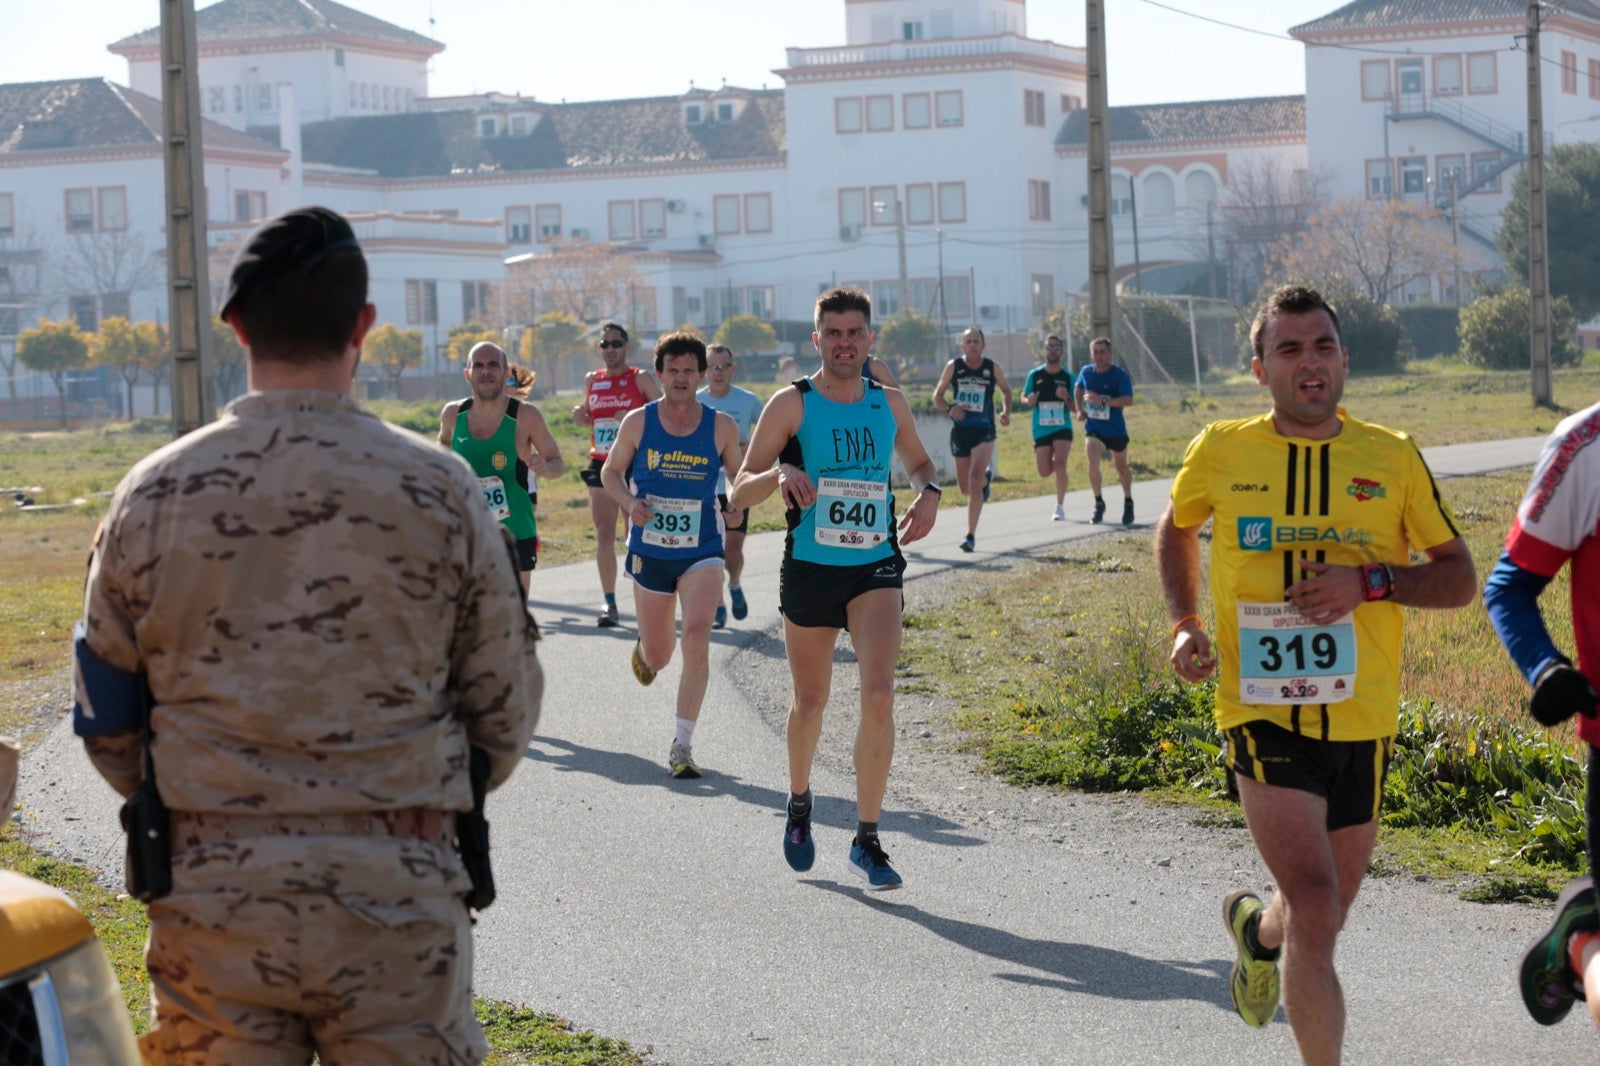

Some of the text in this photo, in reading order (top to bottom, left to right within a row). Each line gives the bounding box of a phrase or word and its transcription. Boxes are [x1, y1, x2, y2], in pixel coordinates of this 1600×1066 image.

[959, 391, 980, 404] 810
[832, 426, 876, 463] ENA
[663, 451, 708, 466] olimpo
[654, 512, 691, 533] 393
[829, 500, 877, 528] 640
[1276, 526, 1341, 543] BSA
[1263, 605, 1283, 617] GRAN
[1260, 633, 1337, 671] 319
